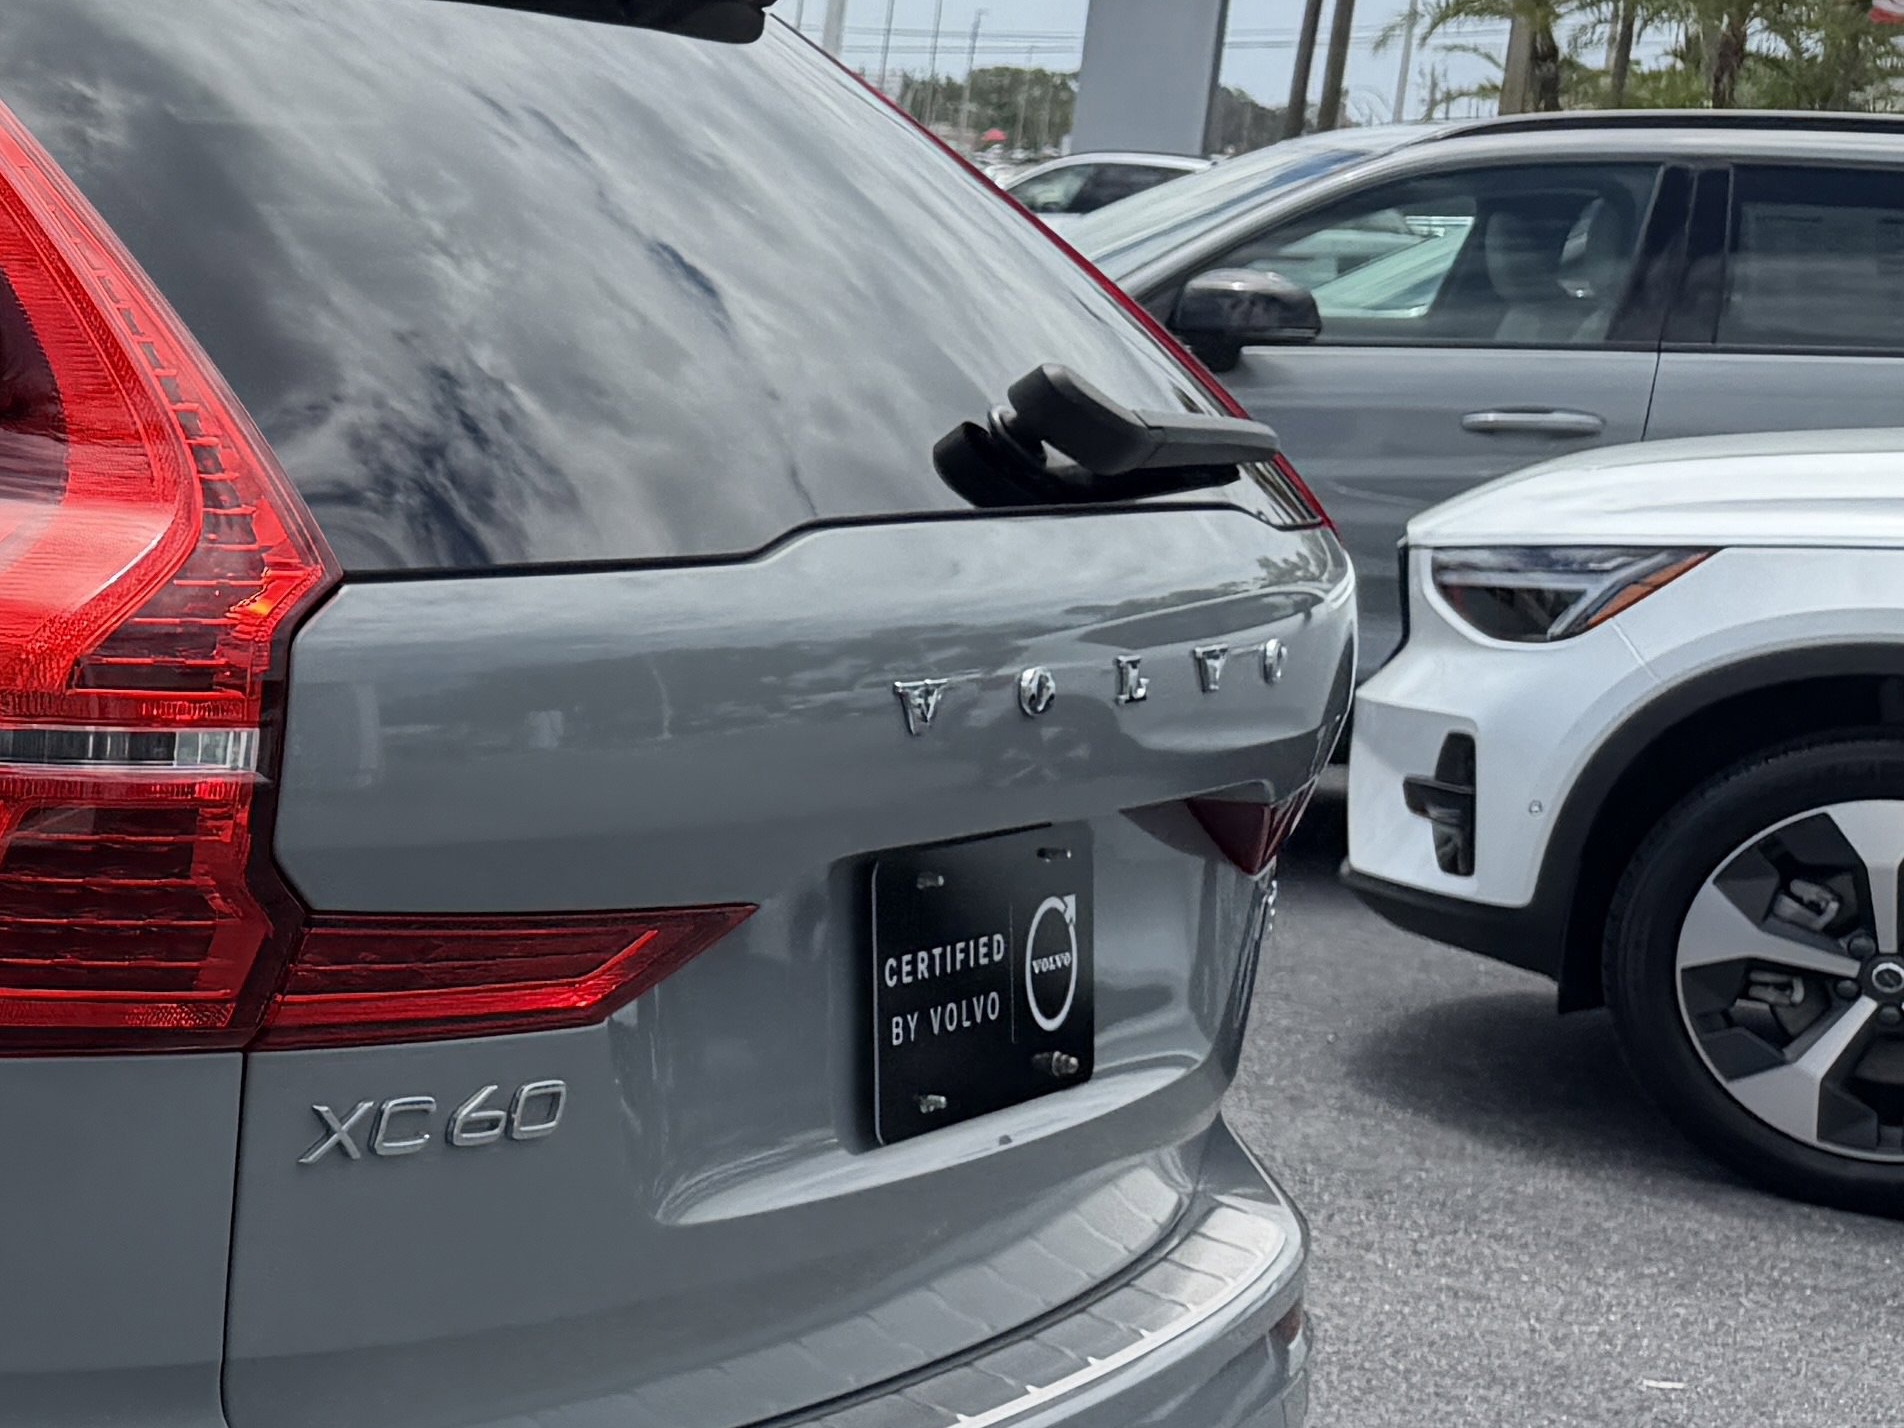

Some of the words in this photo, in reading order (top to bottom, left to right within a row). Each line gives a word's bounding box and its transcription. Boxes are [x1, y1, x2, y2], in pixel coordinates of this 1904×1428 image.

[892, 637, 1289, 737] VOLVO
[884, 932, 1005, 988] CERTIFIED
[1031, 951, 1072, 975] VOLVO
[891, 1011, 919, 1047] BY
[929, 990, 1000, 1036] VOLVO
[297, 1078, 567, 1164] XC60
